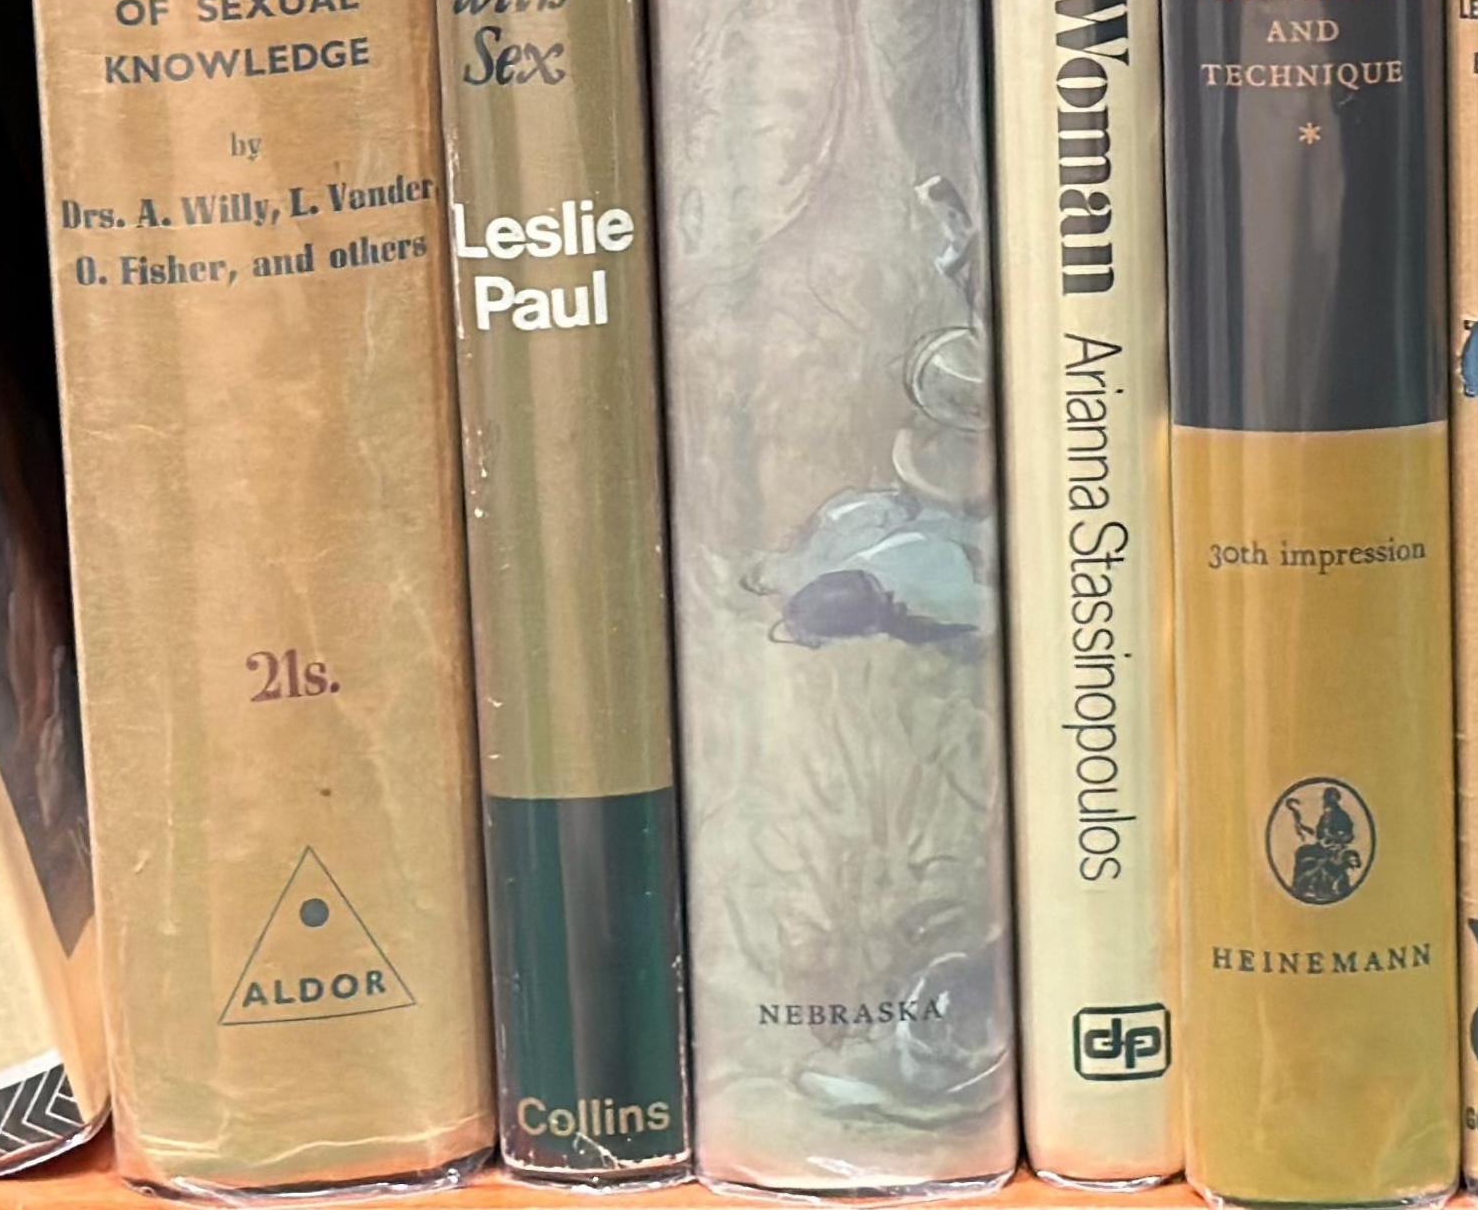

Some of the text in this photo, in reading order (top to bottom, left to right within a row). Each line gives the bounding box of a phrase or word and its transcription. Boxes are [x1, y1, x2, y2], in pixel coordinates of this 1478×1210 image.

[1267, 20, 1339, 42] AND
[105, 37, 369, 84] KNOWLEDGE
[463, 26, 566, 85] Sex
[1201, 61, 1403, 89] TECHNIQUE
[230, 132, 261, 161] by
[62, 191, 279, 229] Drs. Willy,
[453, 200, 634, 259] Leslie
[121, 234, 427, 287] Fisher, and others
[475, 270, 608, 330] Paul
[1209, 541, 1268, 568] 30th
[1061, 332, 1136, 882] Arianna Stassinopoulos
[1212, 944, 1431, 974] HEINEMANN
[242, 970, 387, 1007] ALDOR
[759, 997, 943, 1025] NEBRASKA
[517, 1097, 671, 1137] Collins
